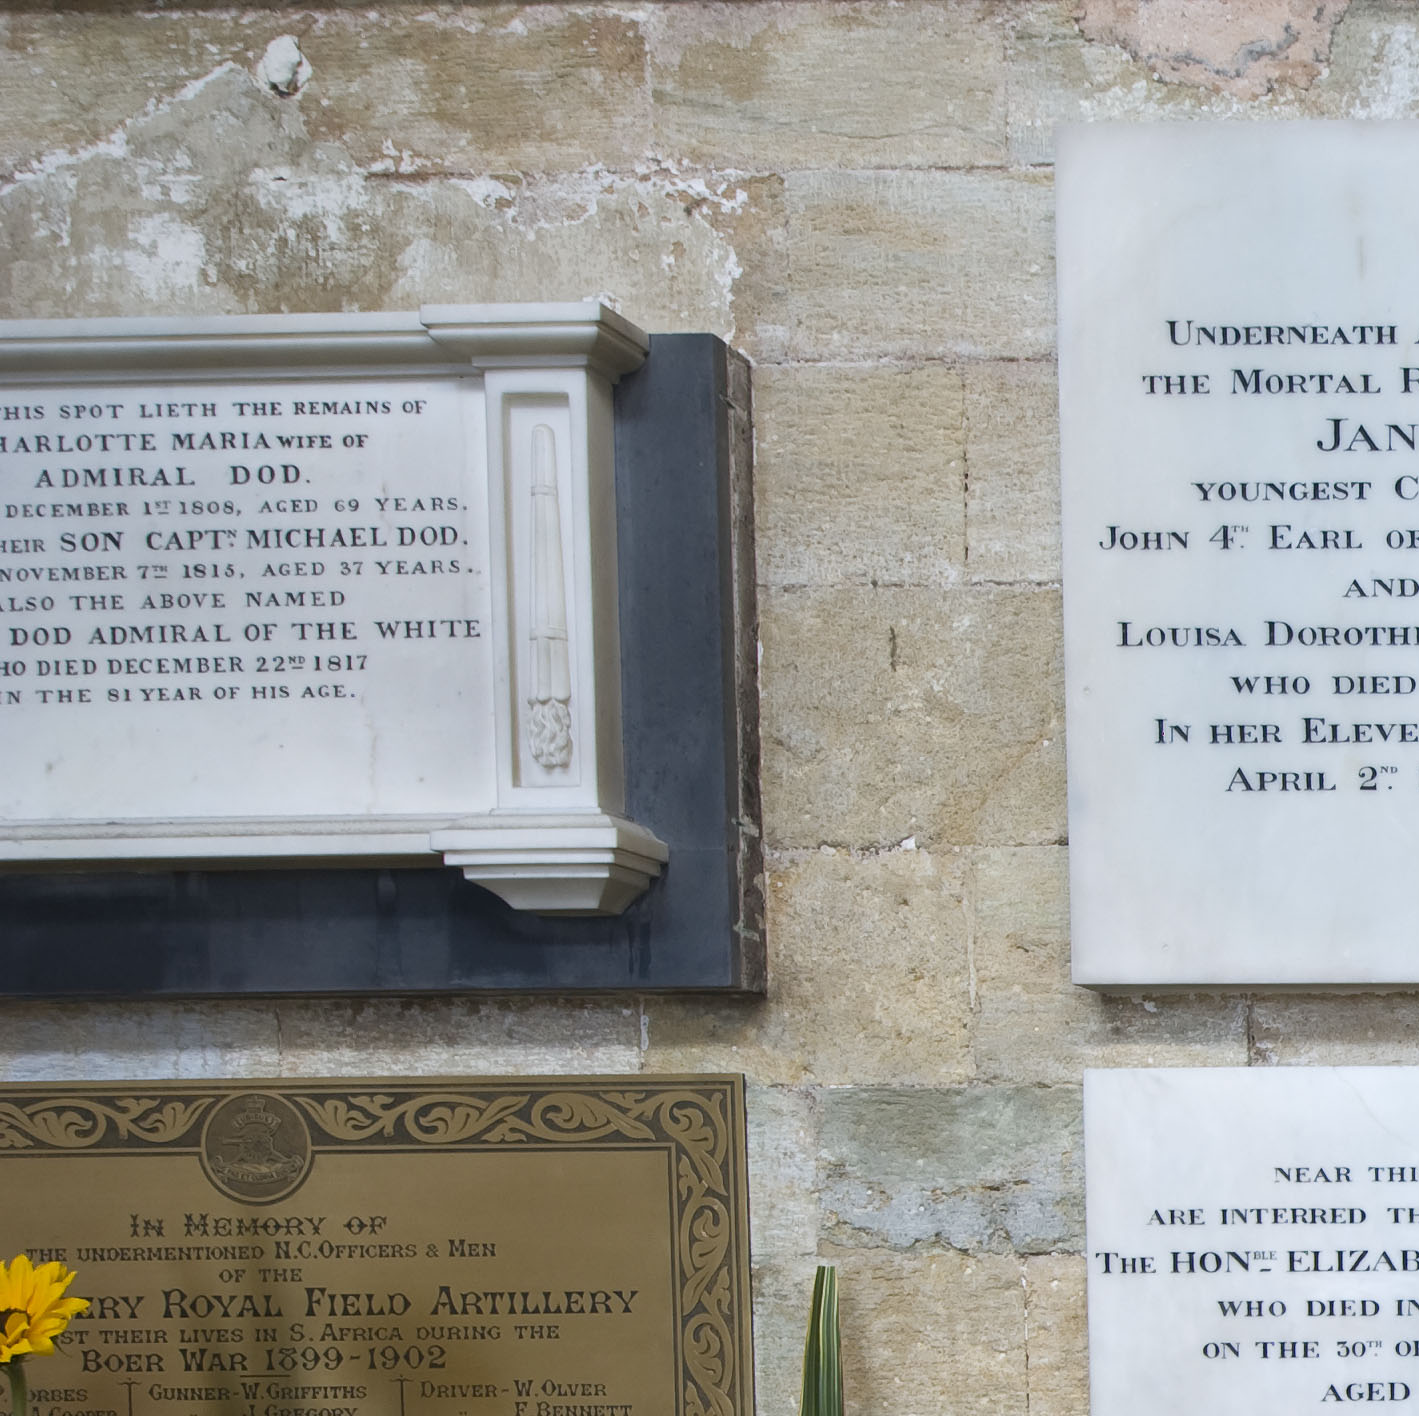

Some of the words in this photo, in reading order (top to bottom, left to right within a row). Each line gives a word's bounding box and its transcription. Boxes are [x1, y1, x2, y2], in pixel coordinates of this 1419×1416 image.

[1142, 375, 1210, 394] THE
[172, 432, 271, 450] MARIA
[276, 435, 332, 448] WIFE
[342, 434, 368, 448] OF
[35, 467, 195, 488] ADMIRAL
[230, 465, 310, 485] DOD.
[1191, 482, 1371, 501] YOUNGEST
[5, 502, 130, 518] DECEMBER
[179, 500, 241, 516] 1808,
[258, 499, 318, 513] AGED
[334, 499, 359, 512] 69
[375, 497, 467, 511] YEARS.
[60, 532, 124, 552] SON
[246, 527, 387, 549] MICHAEL
[397, 526, 467, 546] DOD.
[1343, 578, 1419, 598] AND
[69, 595, 124, 611] THE
[140, 593, 225, 609] ABOVE
[245, 591, 345, 607] NAMED
[9, 627, 71, 646] DOD
[88, 624, 231, 645] ADMIRAL
[244, 624, 277, 642] OF
[291, 622, 357, 640] THE
[374, 620, 480, 639] WHITE
[37, 659, 97, 676] DIED
[107, 656, 244, 674] DECEMBER
[314, 655, 367, 671] 1817
[1230, 676, 1310, 694] WHO
[1332, 676, 1416, 694] DIED
[1210, 724, 1282, 744] HER
[1275, 1167, 1351, 1183] NEAR
[1096, 1253, 1156, 1273] THE
[1218, 1301, 1286, 1317] WHO
[1307, 1300, 1379, 1316] DIED
[1203, 1342, 1240, 1359] ON
[1255, 1342, 1319, 1359] THE
[1321, 1382, 1410, 1402] AGED
